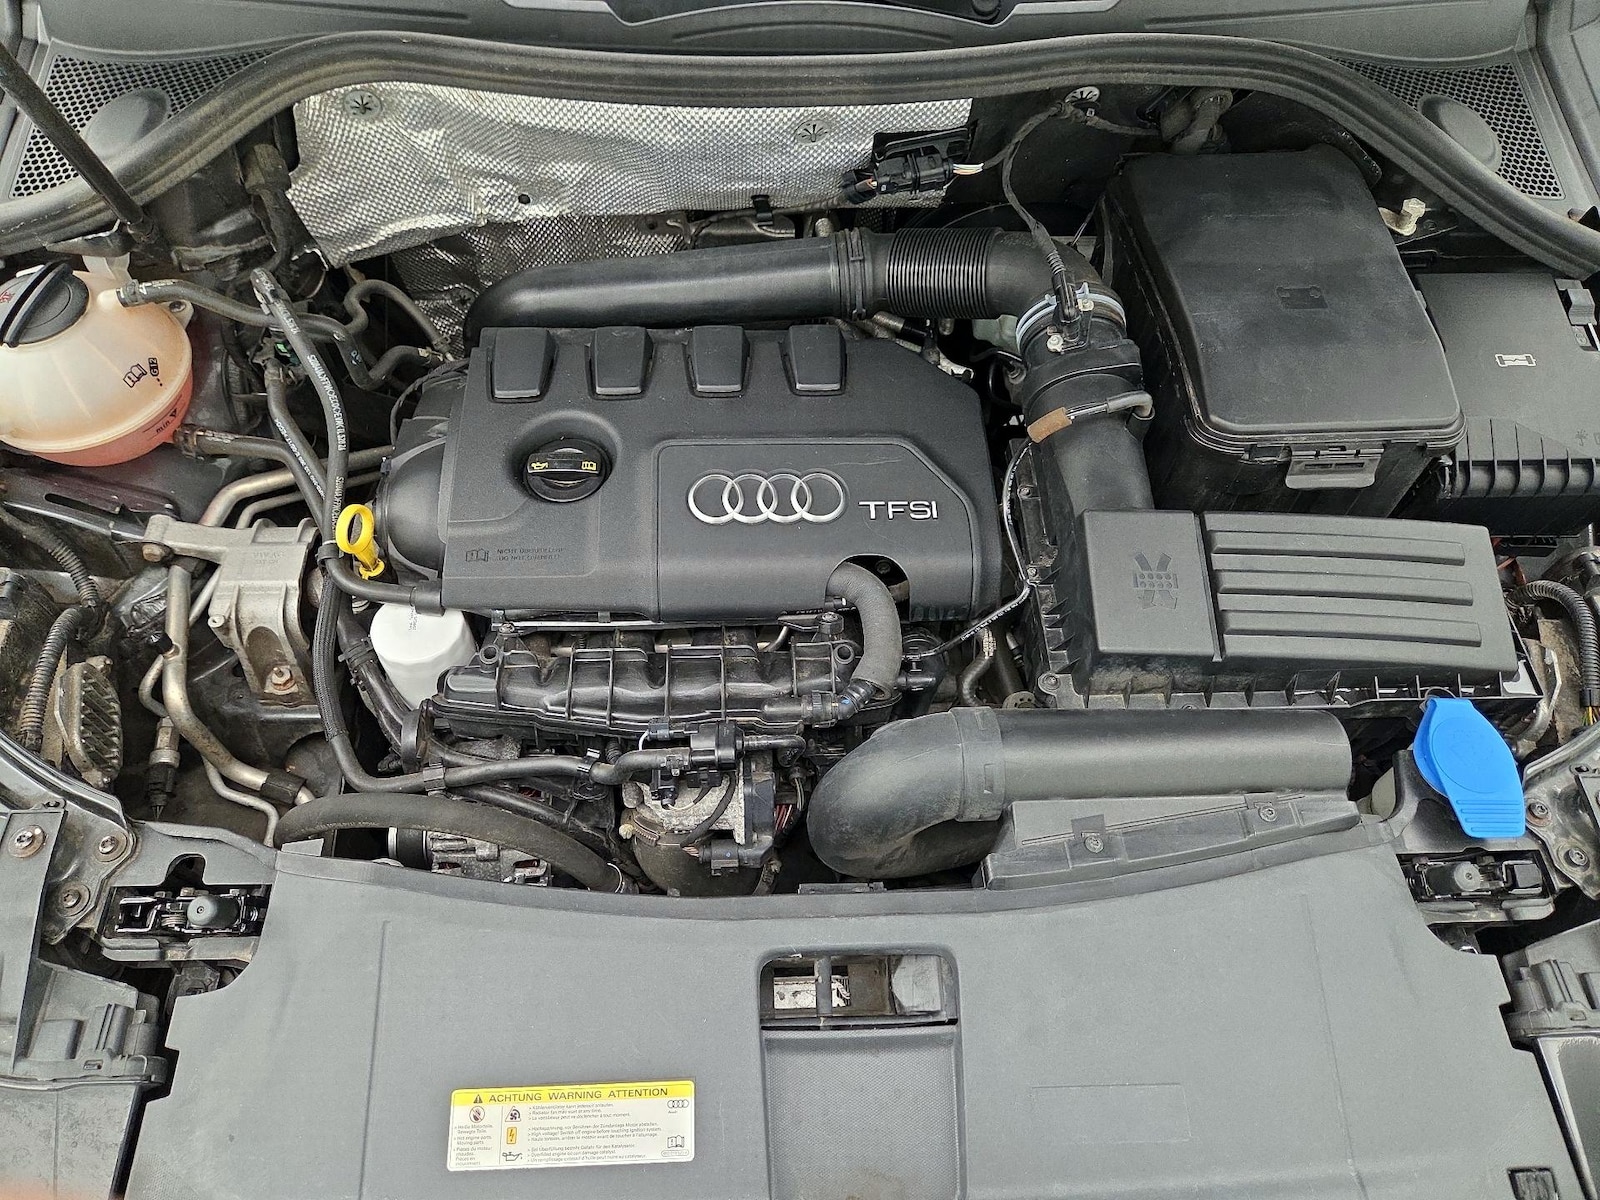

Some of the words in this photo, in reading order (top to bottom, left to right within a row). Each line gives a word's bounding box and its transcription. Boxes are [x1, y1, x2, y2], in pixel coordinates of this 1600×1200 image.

[150, 358, 159, 376] G12
[156, 420, 171, 433] min
[858, 500, 938, 520] TFSI
[489, 1093, 542, 1102] ACHTUNG
[548, 1090, 602, 1100] WARNING
[608, 1088, 668, 1098] ATTENTION
